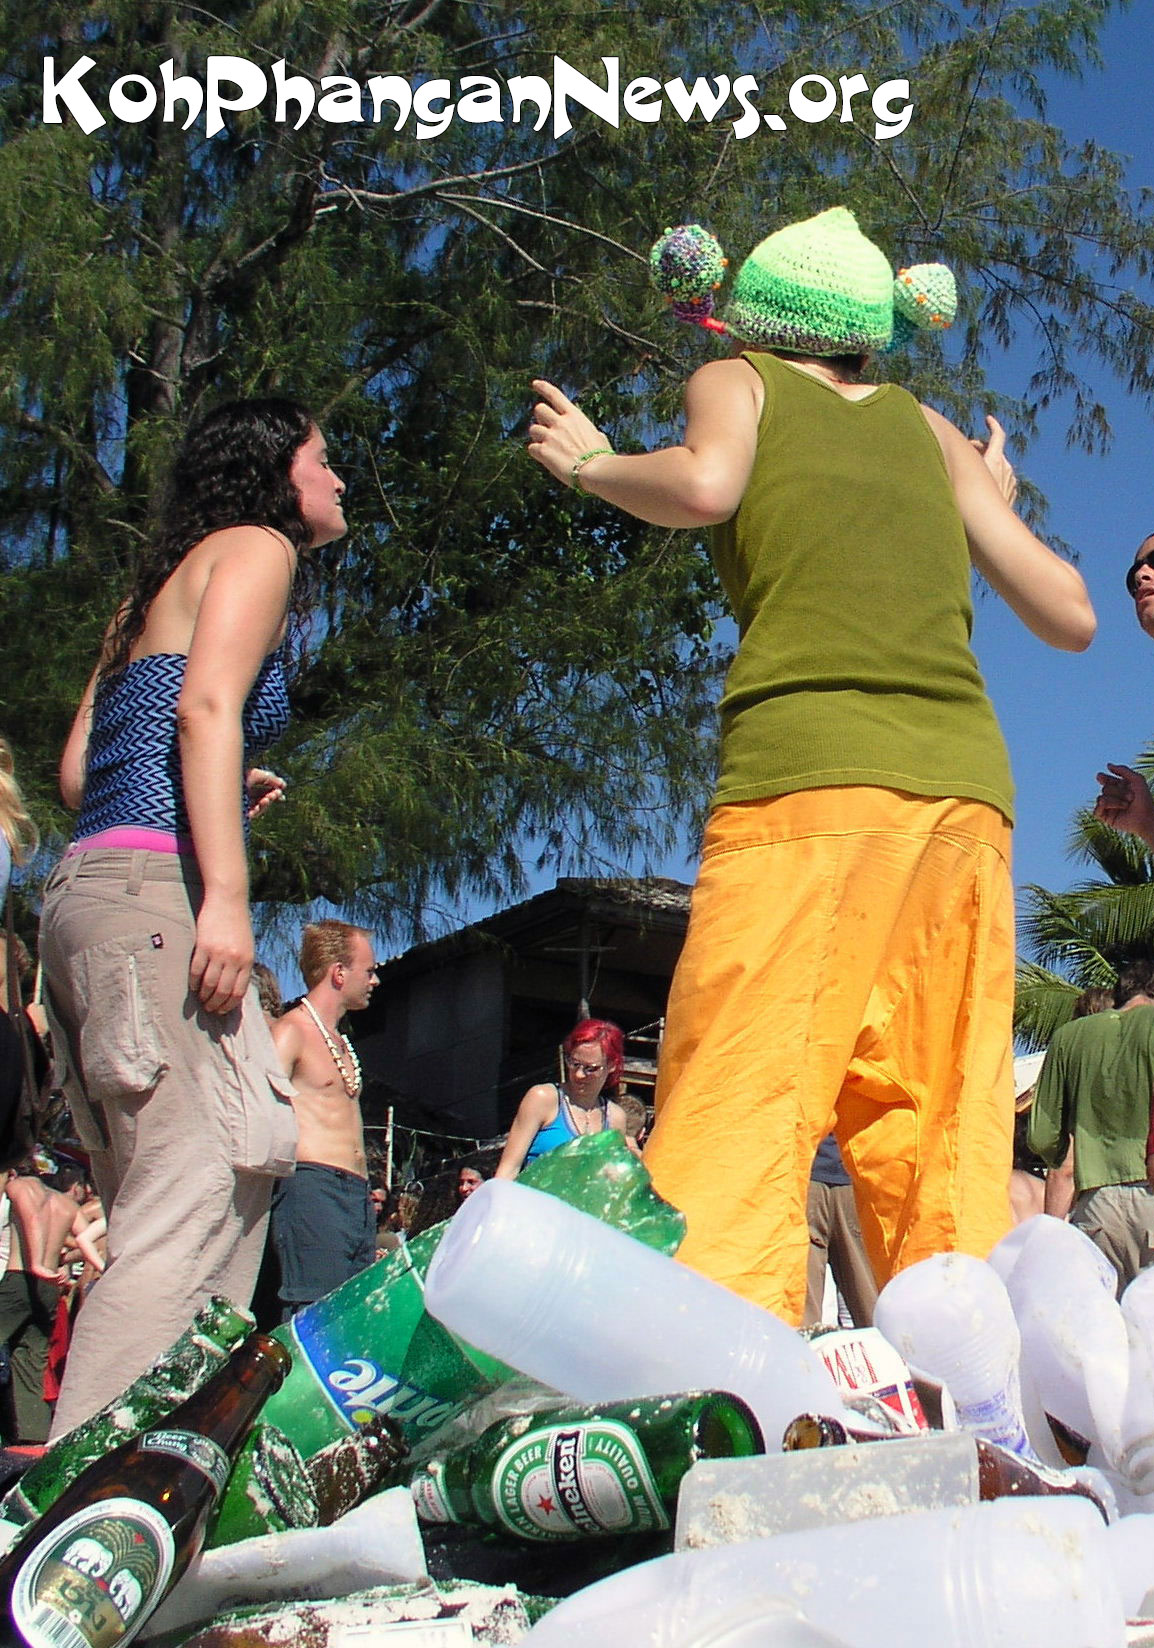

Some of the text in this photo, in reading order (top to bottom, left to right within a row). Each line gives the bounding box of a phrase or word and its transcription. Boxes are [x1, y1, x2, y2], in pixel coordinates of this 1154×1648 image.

[328, 1359, 465, 1427] prite
[504, 1470, 521, 1514] LAGER
[514, 1445, 542, 1473] BEER
[594, 1437, 639, 1490] QUALITY
